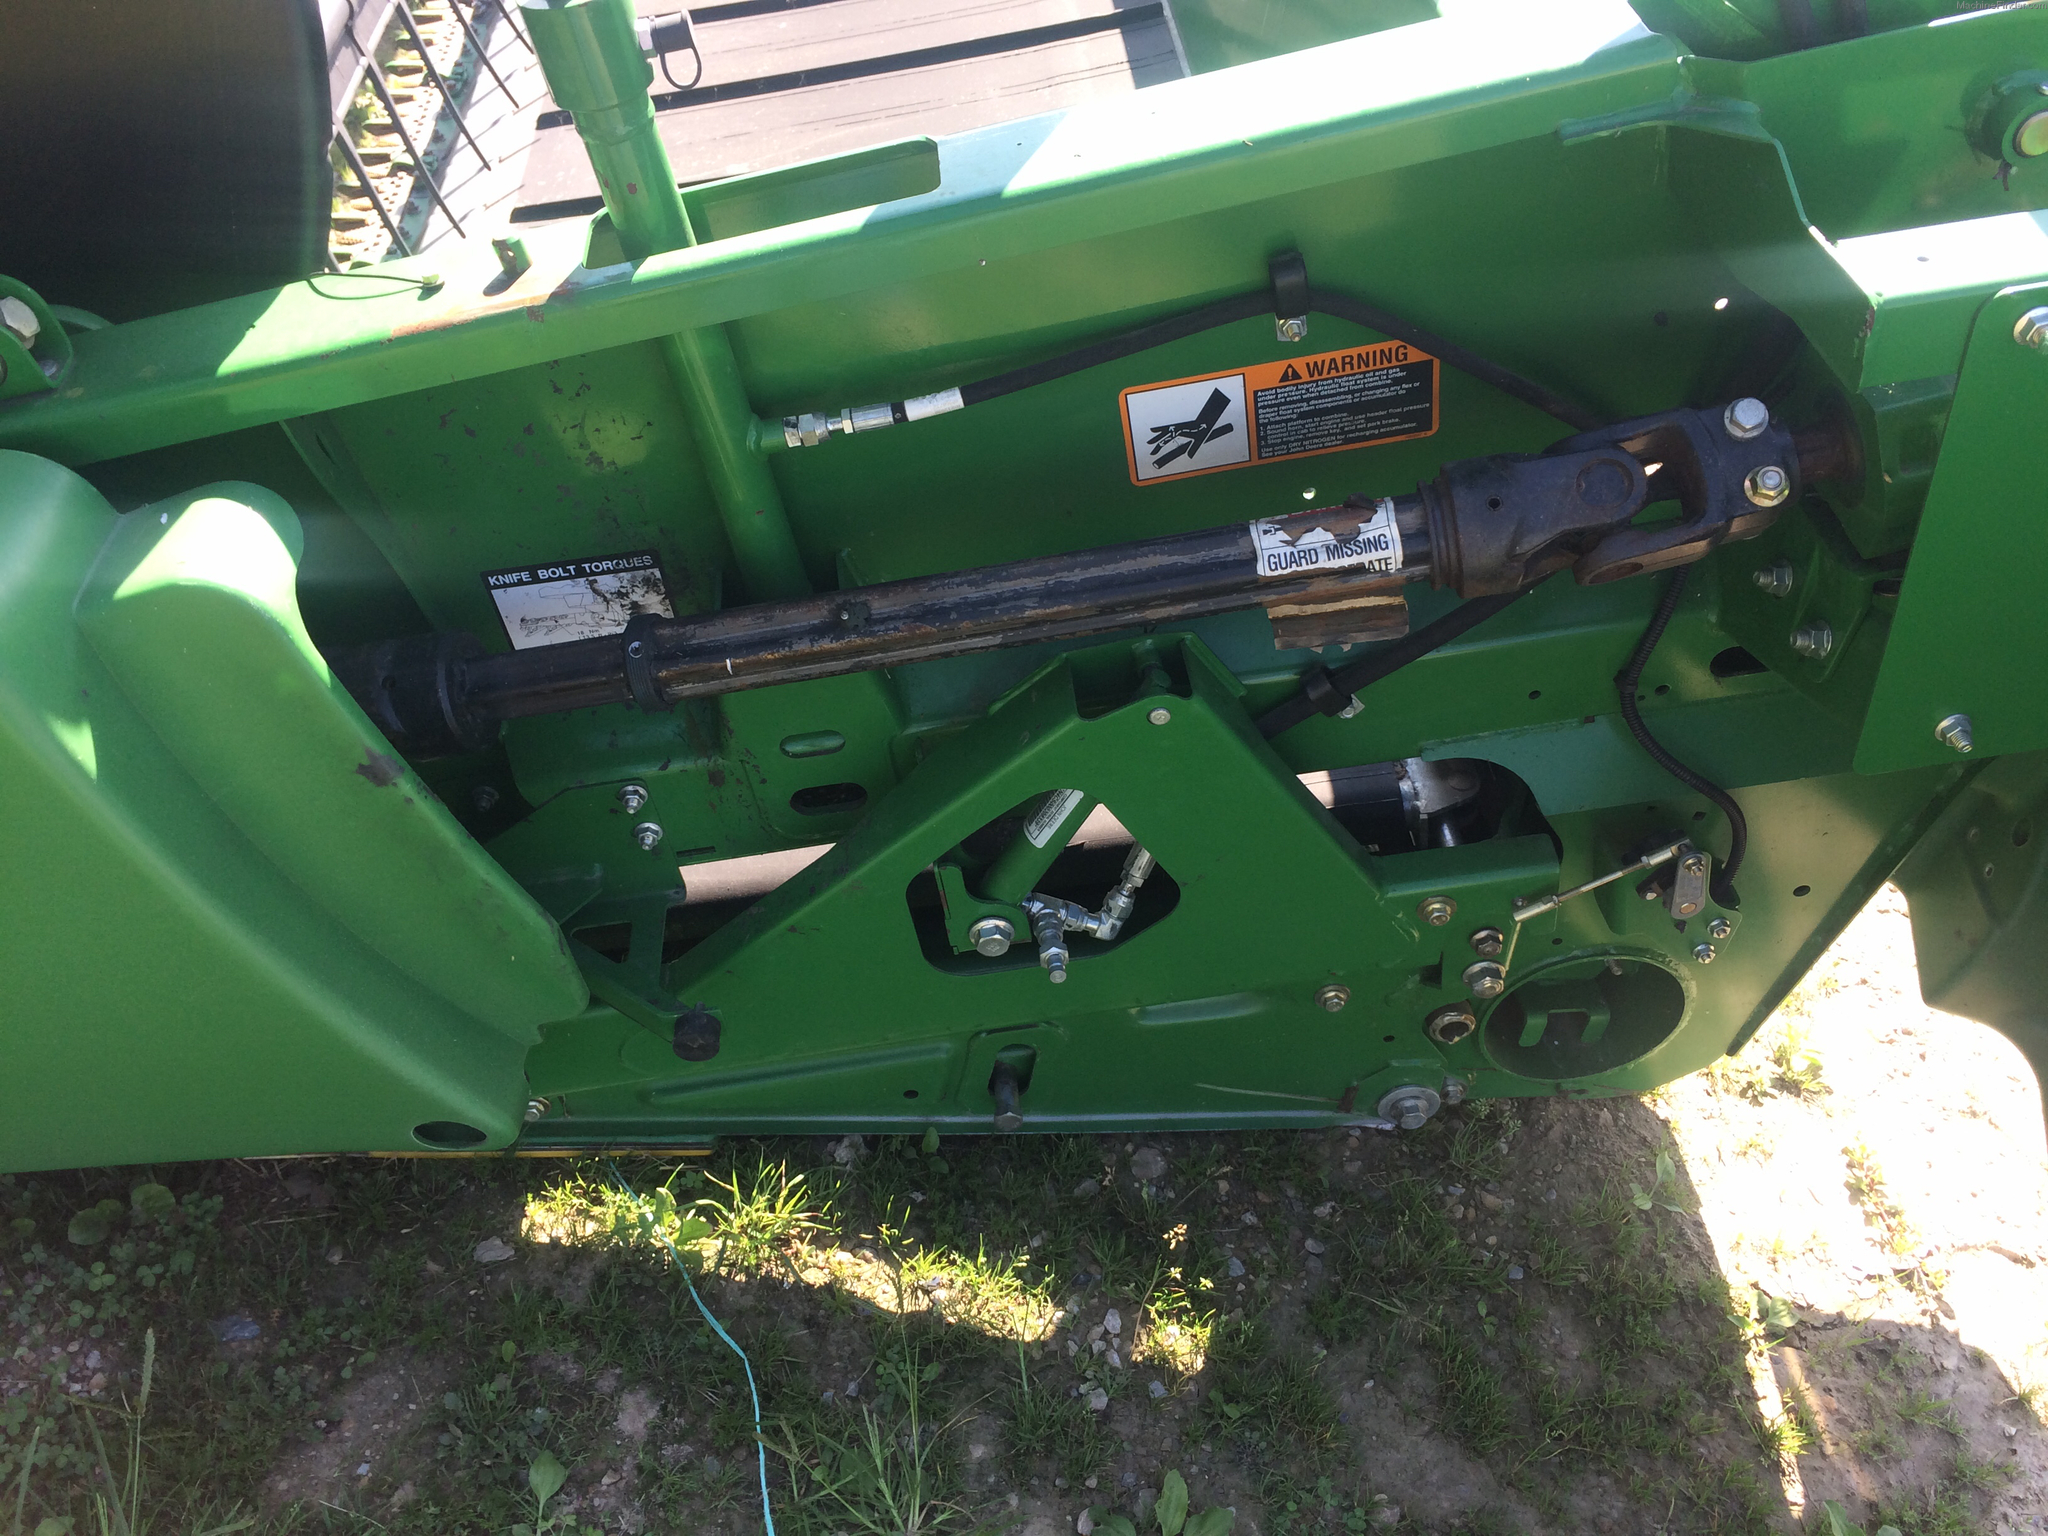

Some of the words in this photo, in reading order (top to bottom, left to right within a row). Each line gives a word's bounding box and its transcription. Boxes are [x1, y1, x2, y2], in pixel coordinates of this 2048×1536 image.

[1306, 345, 1408, 378] WARNING
[1257, 389, 1276, 397] Avoid
[1334, 373, 1364, 383] hydraulic
[1257, 399, 1285, 407] pressure
[1320, 387, 1346, 396] detached
[1309, 383, 1339, 393] Hydraulic
[1362, 387, 1389, 396] changing
[1267, 548, 1319, 572] GUARD
[1325, 533, 1390, 561] MISSING
[488, 571, 532, 586] KNIFE
[537, 565, 576, 580] BOLT
[582, 555, 653, 574] TORQUES
